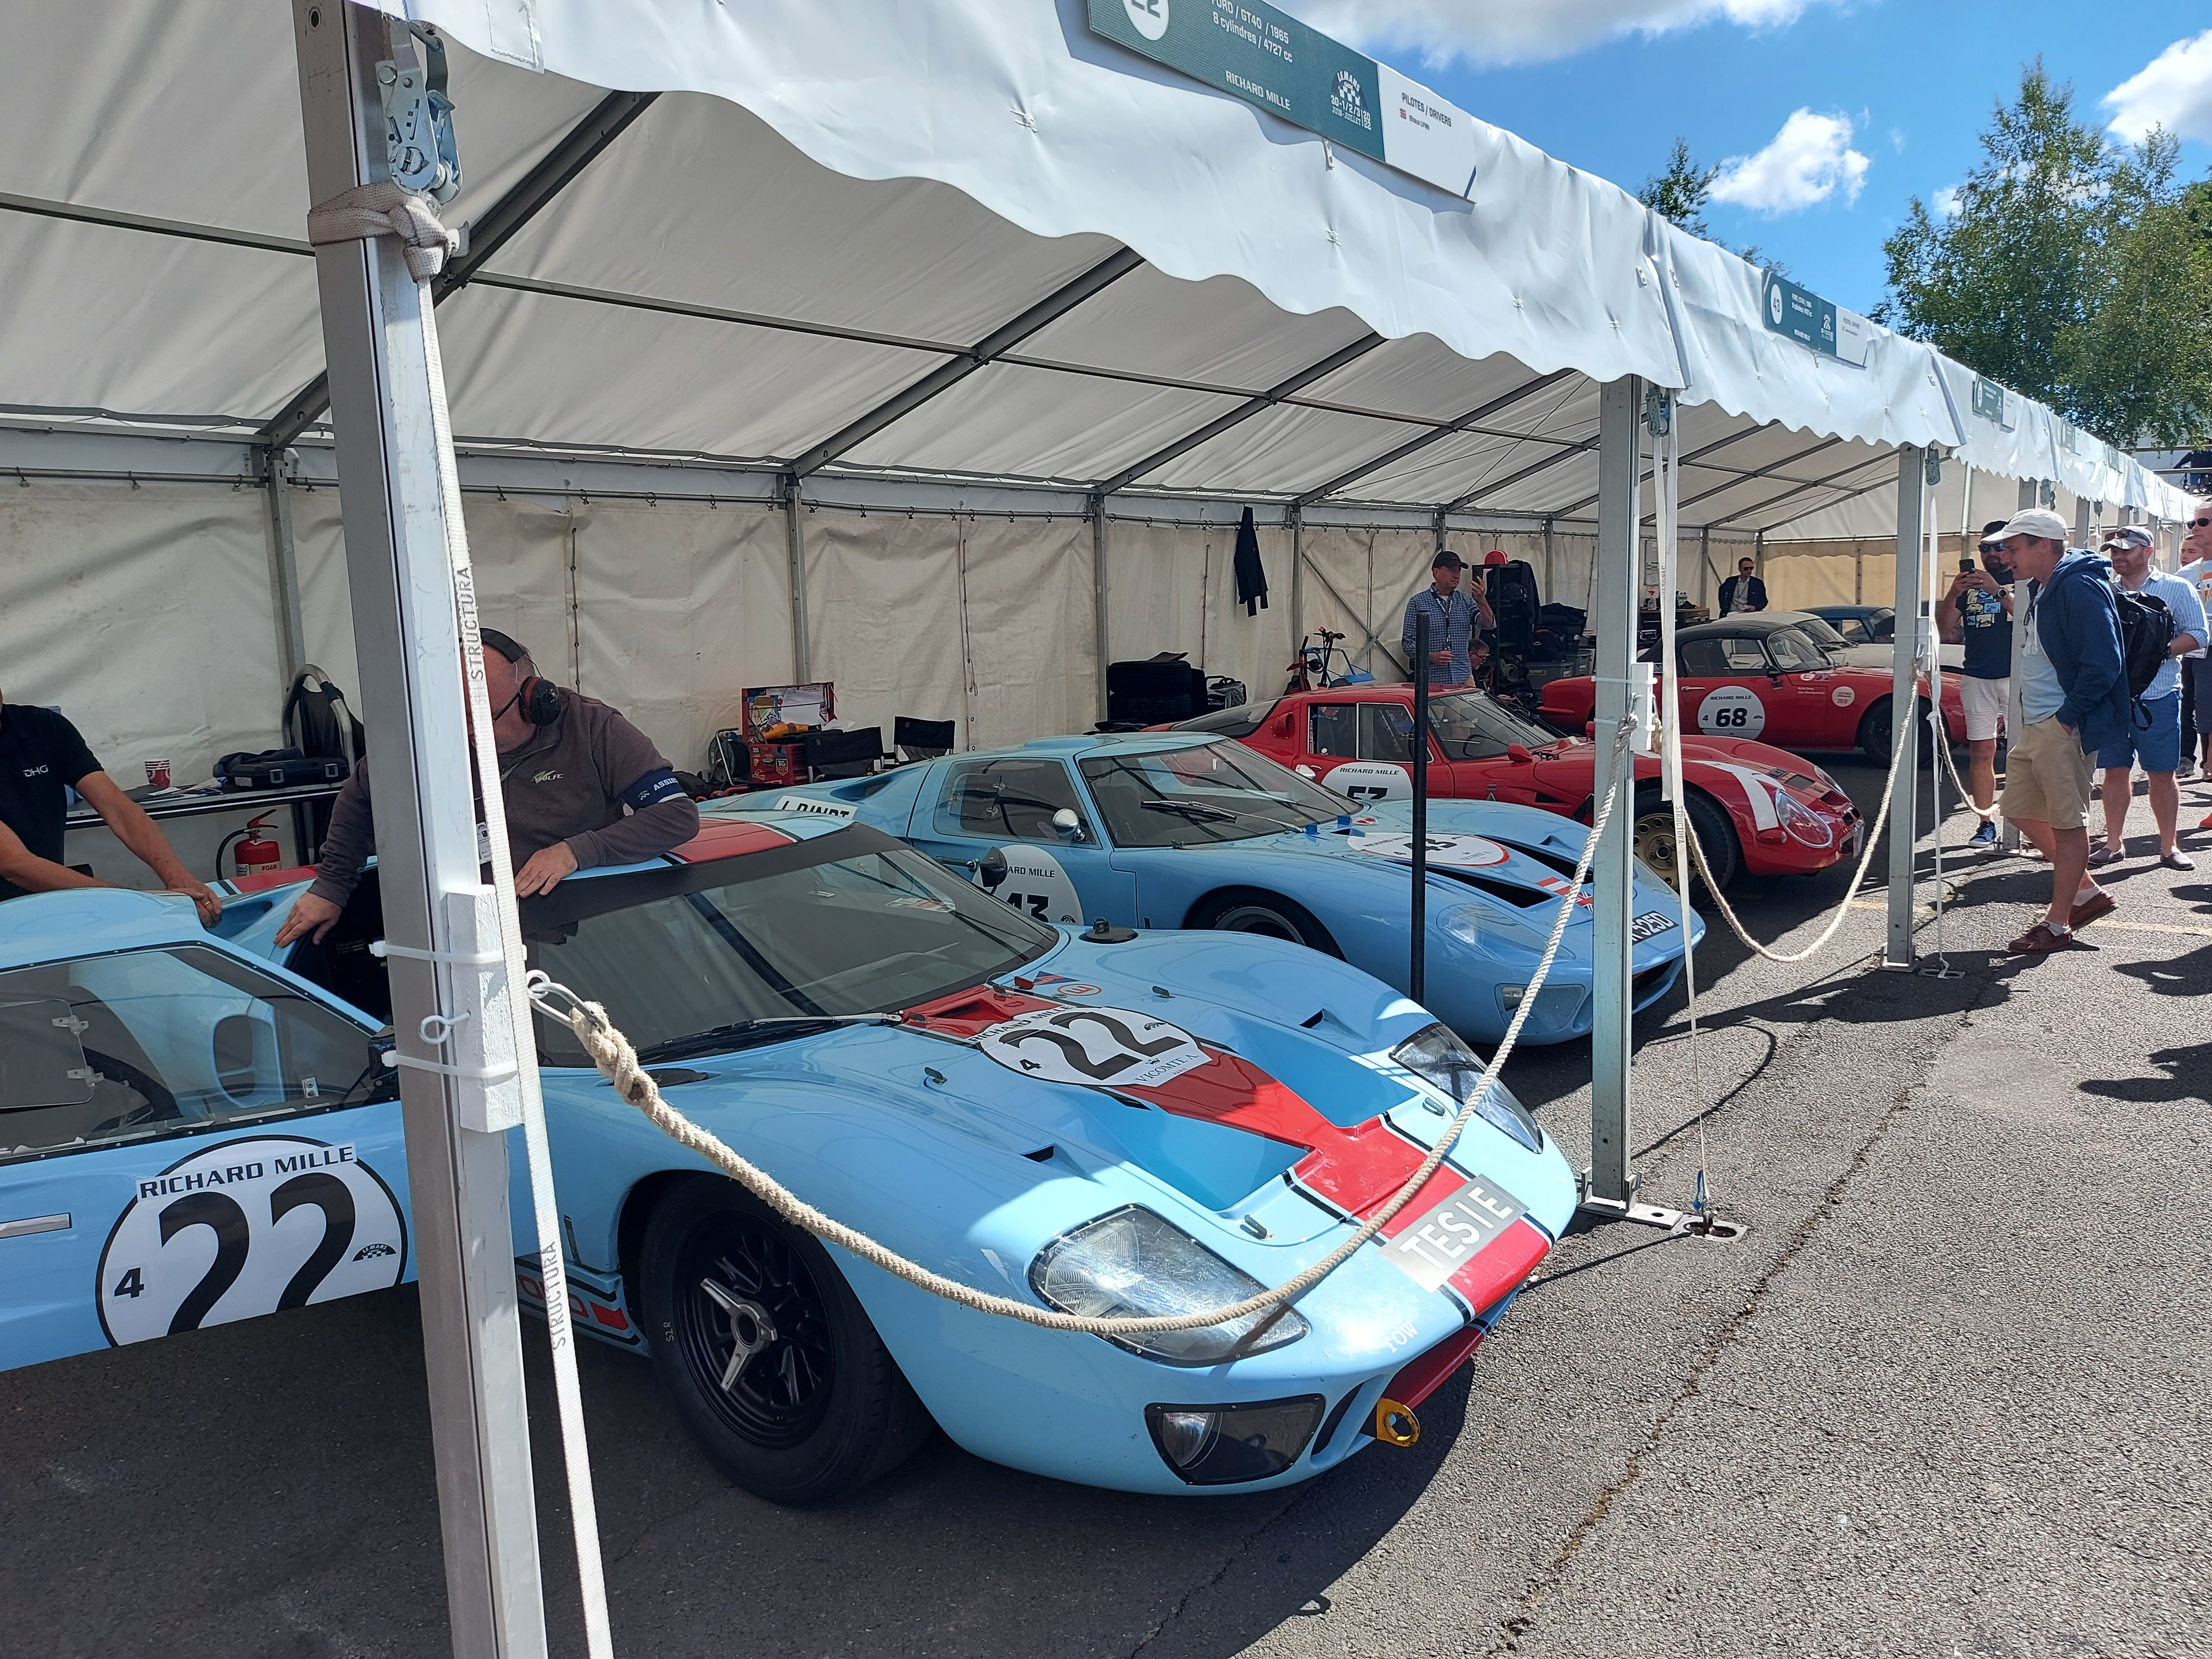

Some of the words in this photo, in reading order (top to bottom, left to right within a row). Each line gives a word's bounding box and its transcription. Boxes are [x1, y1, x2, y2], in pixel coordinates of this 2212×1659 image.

[1213, 11, 1219, 24] 8
[1220, 17, 1256, 44] cylindres
[1258, 35, 1262, 49] /
[1263, 38, 1282, 57] 4727
[1283, 51, 1293, 63] cc
[1235, 5, 1239, 19] /
[1240, 9, 1262, 30] GT40
[1265, 22, 1269, 35] /
[1270, 24, 1289, 44] 1965
[1226, 70, 1264, 98] RICHARD
[1266, 89, 1291, 111] MILLE
[1402, 92, 1425, 112] PILOTES
[1429, 107, 1451, 127] DRIVERS
[1773, 298, 1780, 313] 43
[457, 567, 484, 680] STRUCTURA
[1715, 708, 1747, 727] 68
[23, 765, 49, 777] DHG
[1675, 806, 1685, 843] STRUCTURA
[1007, 866, 1026, 875] ARD
[1029, 868, 1055, 878] MILLE
[968, 1019, 1032, 1043] RICHARD
[1030, 1005, 1073, 1020] MILLE
[999, 1012, 1189, 1081] 22
[1019, 1059, 1042, 1072] 4
[1134, 1057, 1188, 1082] VICOMTE
[140, 1162, 263, 1199] RICHARD
[275, 1147, 354, 1174] MILLE
[1398, 1186, 1514, 1271] TESIE
[159, 1172, 355, 1336] 22
[114, 1267, 144, 1298] 4
[541, 1241, 566, 1350] STRUCTURA
[1384, 1320, 1419, 1353] TOW
